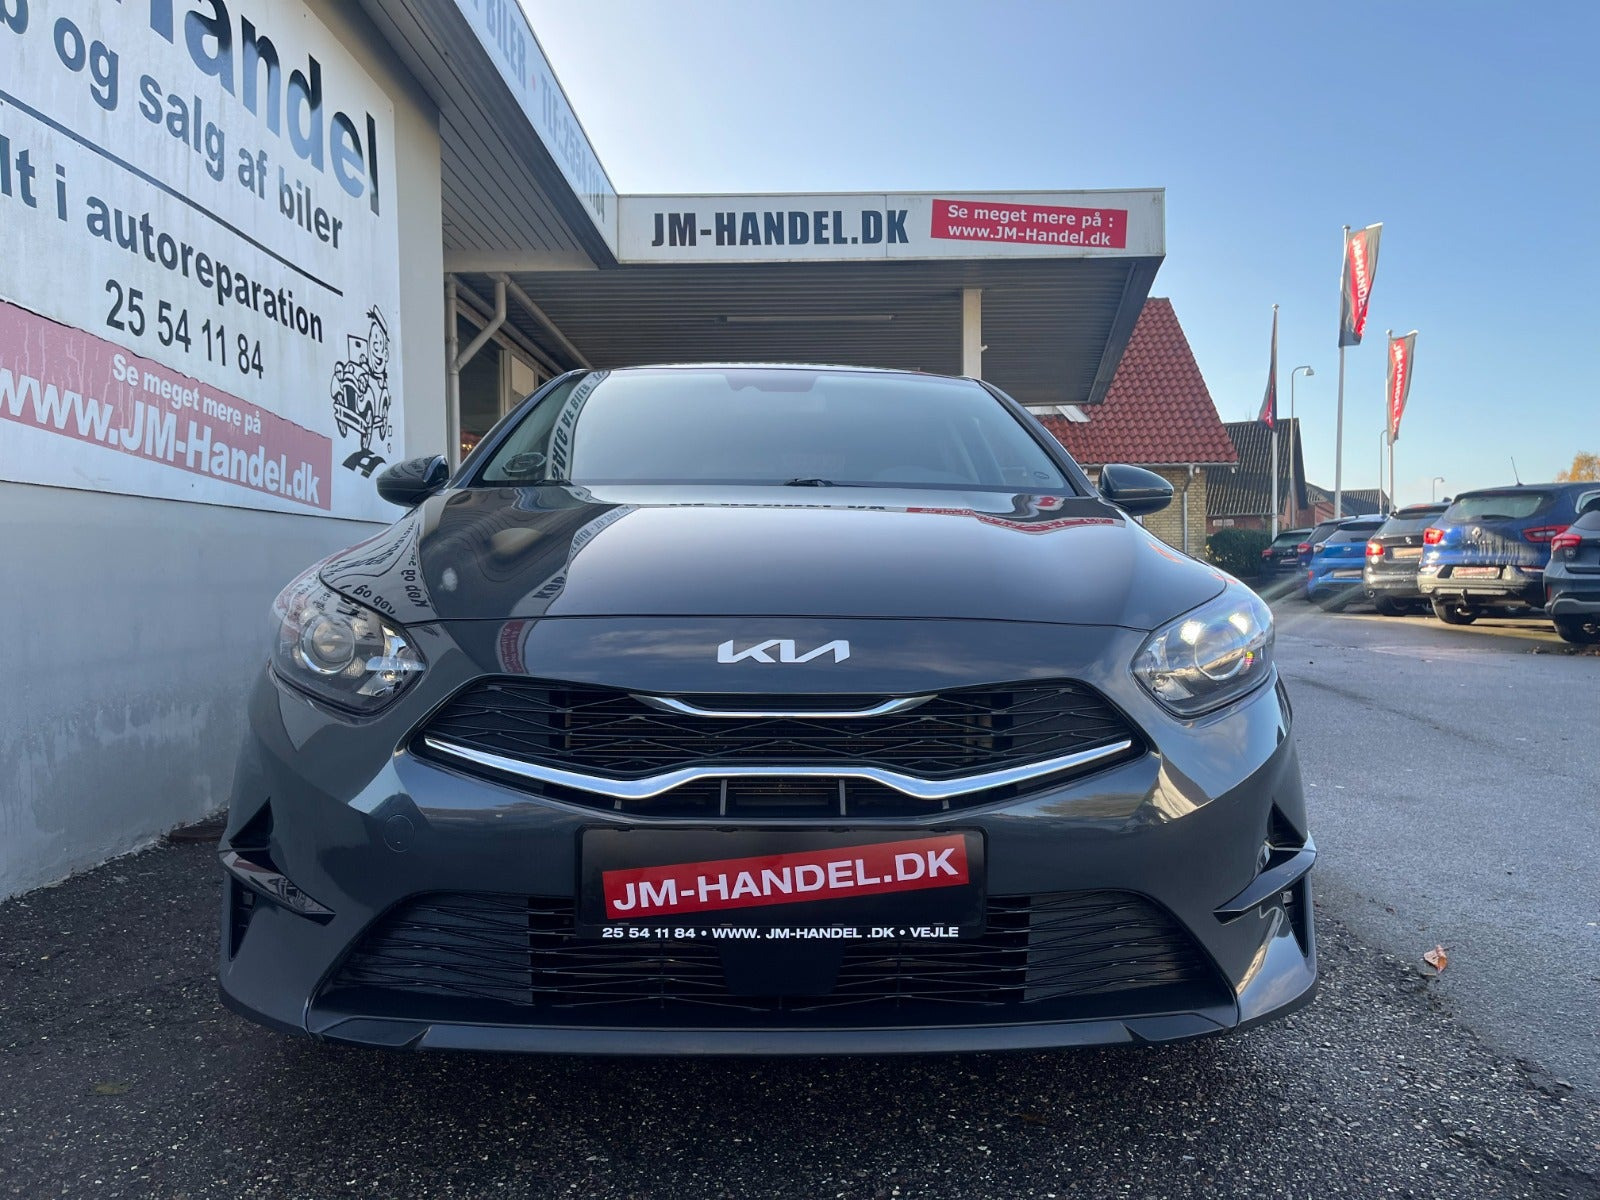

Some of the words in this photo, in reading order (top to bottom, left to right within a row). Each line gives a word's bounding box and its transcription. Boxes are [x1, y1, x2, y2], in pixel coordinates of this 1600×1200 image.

[53, 17, 119, 111] og
[138, 74, 225, 182] salg
[238, 147, 268, 200] af
[278, 166, 343, 249] biler
[651, 209, 909, 247] JM-HANDEL.DK
[948, 205, 968, 218] Se
[974, 207, 1027, 224] meget
[1033, 210, 1076, 225] mere
[1082, 212, 1102, 229] på
[948, 225, 1111, 246] www.JM-Handel.dk
[56, 163, 67, 222] i
[86, 196, 323, 343] autoreparation
[105, 279, 145, 337] 25
[158, 299, 191, 353] 54
[202, 318, 226, 367] 11
[238, 333, 264, 379] 84
[112, 353, 139, 386] Se
[143, 371, 200, 411] meget
[203, 395, 241, 427] mere
[244, 410, 261, 436] på
[717, 639, 850, 664] KIA
[613, 848, 958, 911] JM-HANDEL.DK
[602, 927, 624, 939] 25
[628, 927, 651, 939] 54
[654, 927, 670, 939] 11
[674, 927, 696, 939] 84
[910, 926, 959, 938] VEJLE
